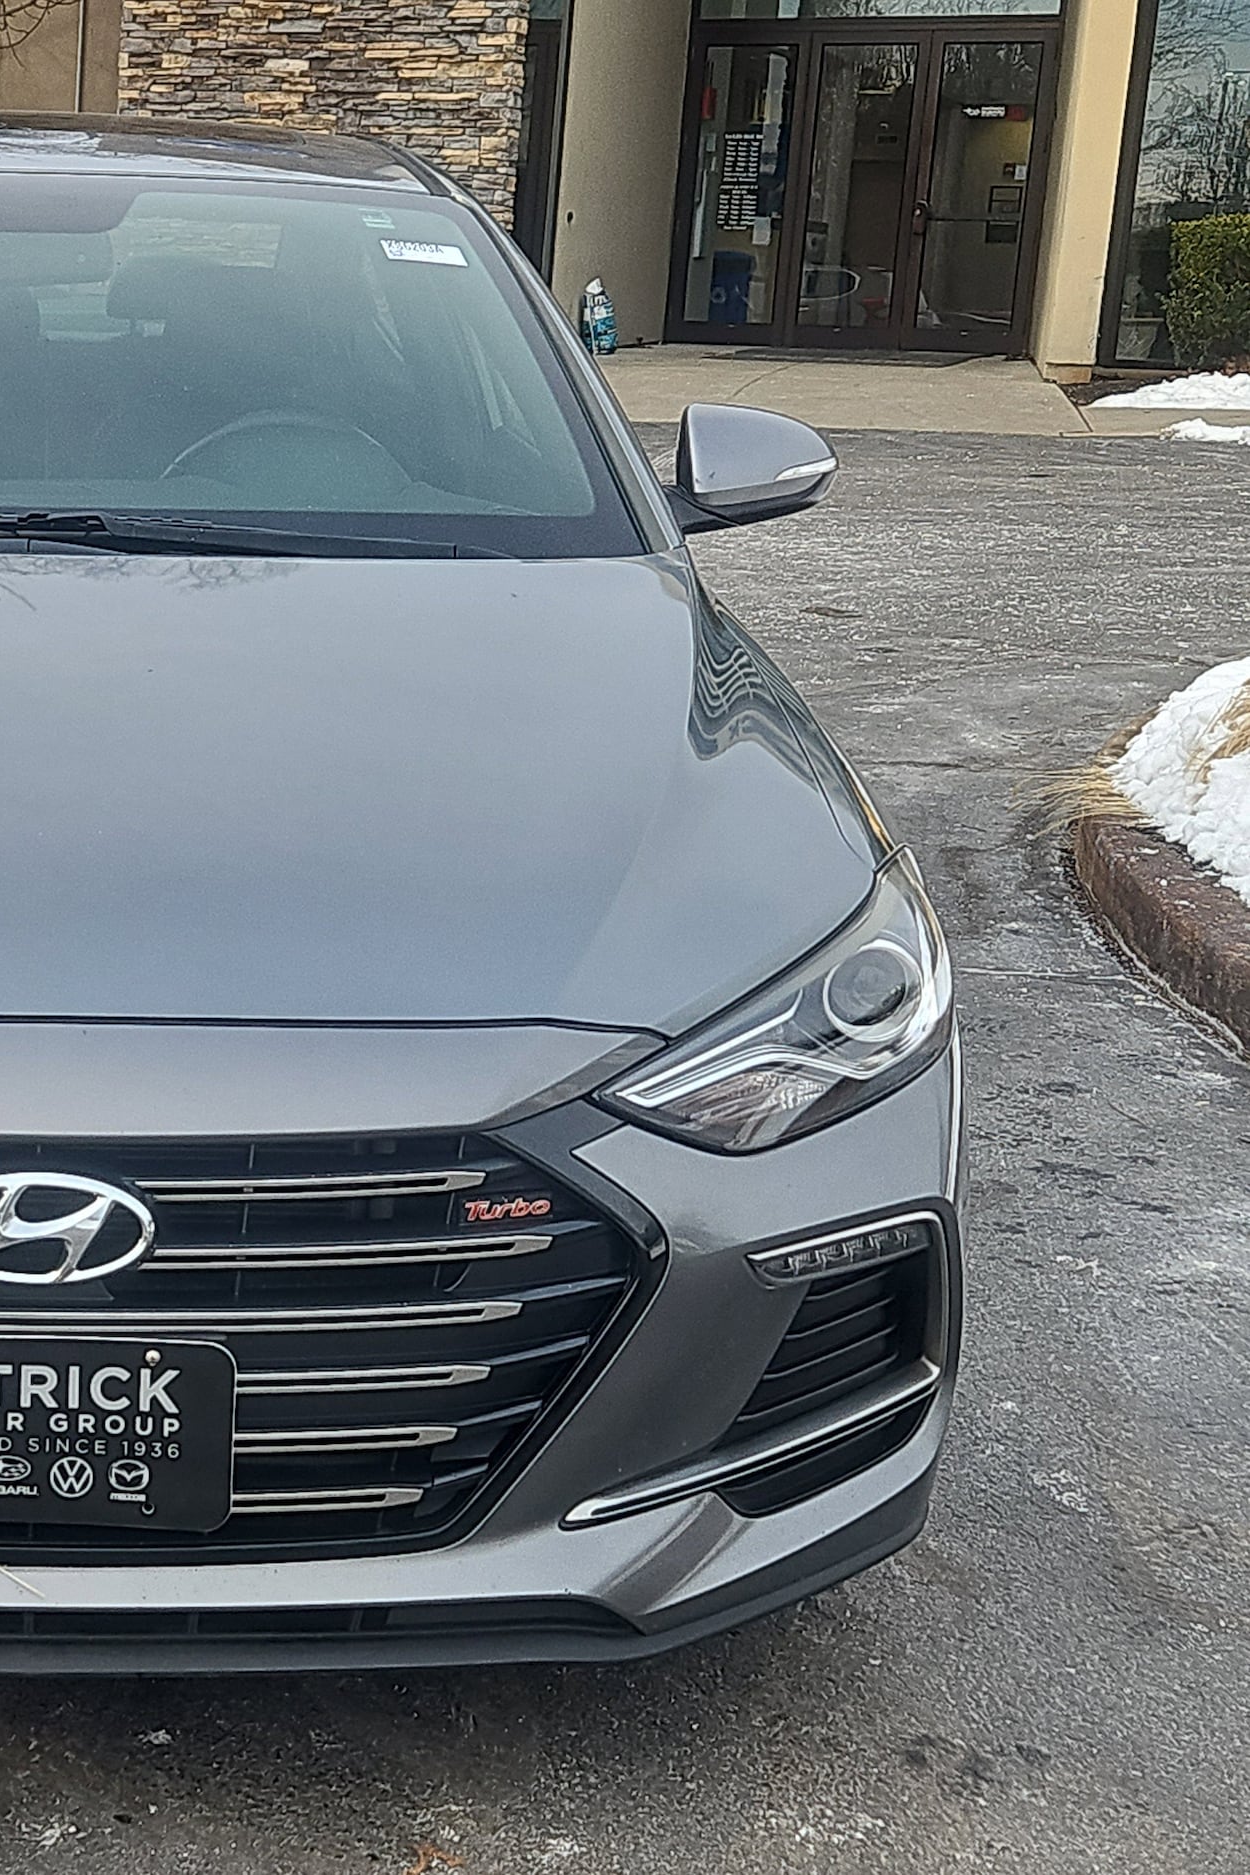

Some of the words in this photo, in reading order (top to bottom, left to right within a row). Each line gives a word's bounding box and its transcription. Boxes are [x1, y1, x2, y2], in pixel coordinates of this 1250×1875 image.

[465, 1197, 550, 1221] Turbo
[49, 1413, 181, 1438] GROUP
[27, 1438, 107, 1456] SINCE
[121, 1441, 180, 1459] 1936
